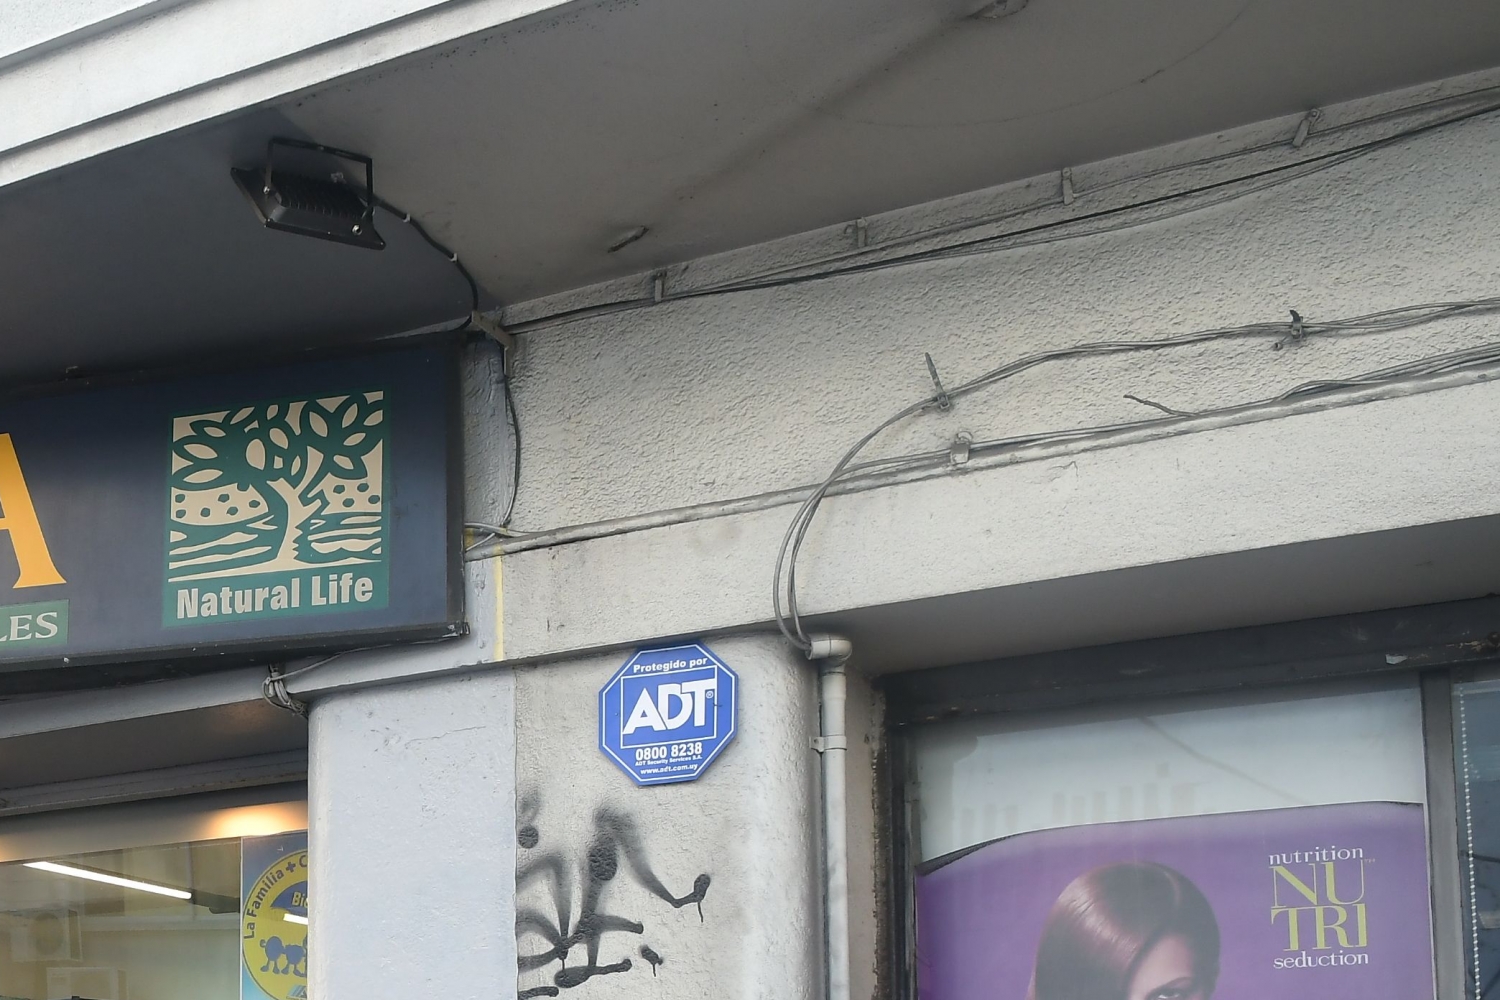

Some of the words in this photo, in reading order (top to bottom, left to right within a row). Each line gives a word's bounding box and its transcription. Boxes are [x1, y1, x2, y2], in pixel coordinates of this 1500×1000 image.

[176, 578, 300, 620] Natural
[310, 572, 374, 607] Life
[633, 661, 687, 673] Protegido
[689, 657, 708, 668] por
[622, 678, 716, 735] ADT
[635, 746, 668, 761] 0800
[670, 742, 703, 757] 8238
[640, 763, 699, 775] www.adt.com.uy
[1268, 845, 1364, 865] nutrition
[1268, 858, 1365, 906] NU
[246, 868, 285, 918] Familia
[244, 921, 256, 939] La
[1270, 903, 1368, 952] TRI
[1273, 950, 1369, 969] seduction
